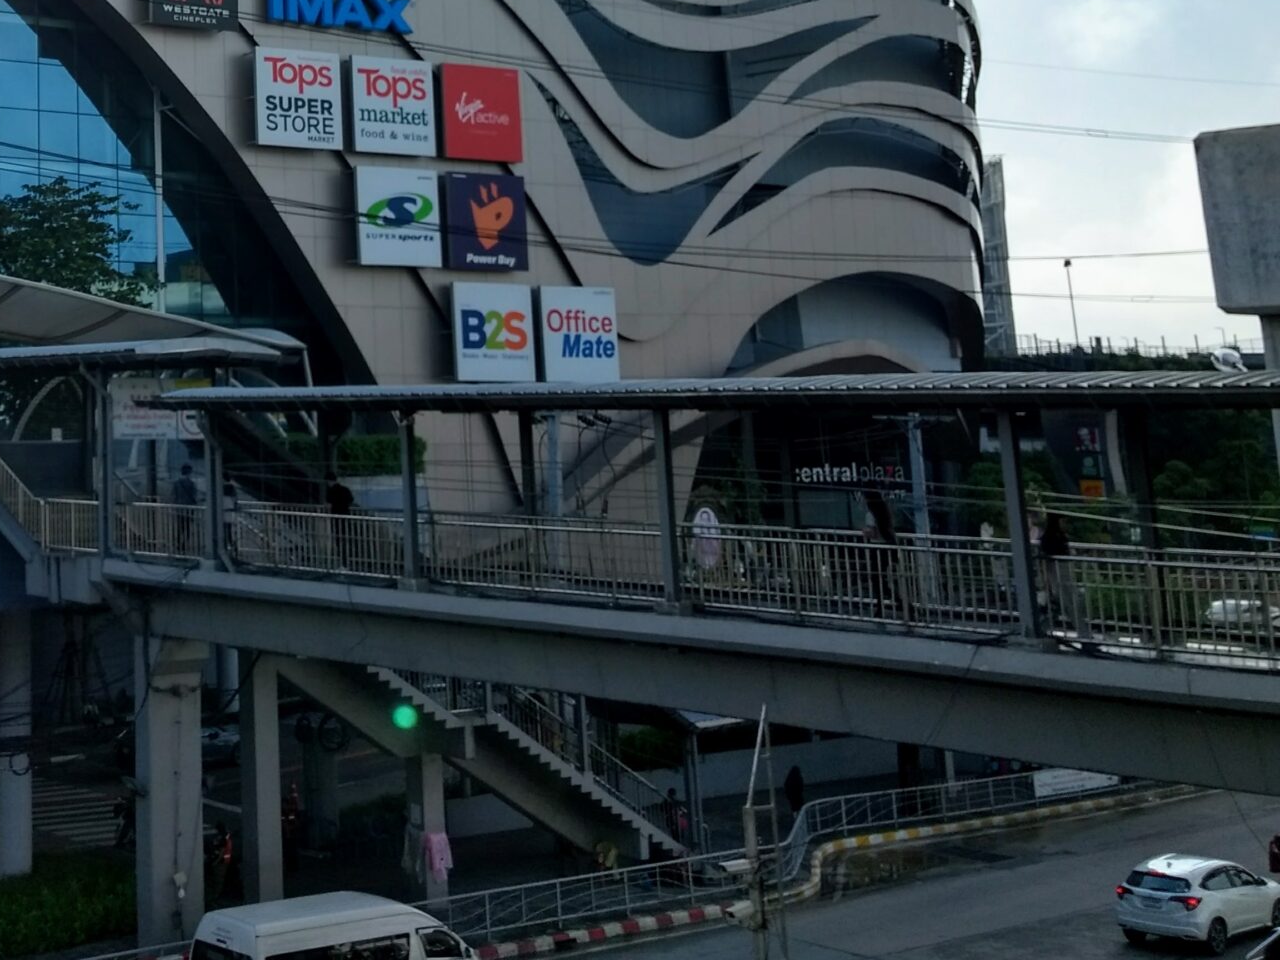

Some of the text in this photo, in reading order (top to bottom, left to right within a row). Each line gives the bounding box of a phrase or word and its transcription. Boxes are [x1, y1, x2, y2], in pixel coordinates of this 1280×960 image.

[163, 4, 230, 17] WESTGATE
[173, 14, 217, 24] CINEPLEX
[264, 56, 333, 94] Tops
[357, 67, 427, 108] Tops
[265, 95, 333, 116] SUPER
[359, 106, 429, 126] market
[266, 113, 335, 135] STORE
[476, 111, 510, 126] active
[360, 129, 429, 142] food & wine
[466, 253, 516, 268] Power Buy
[460, 309, 528, 350] B2S
[546, 308, 613, 333] Office
[562, 334, 616, 358] Mate
